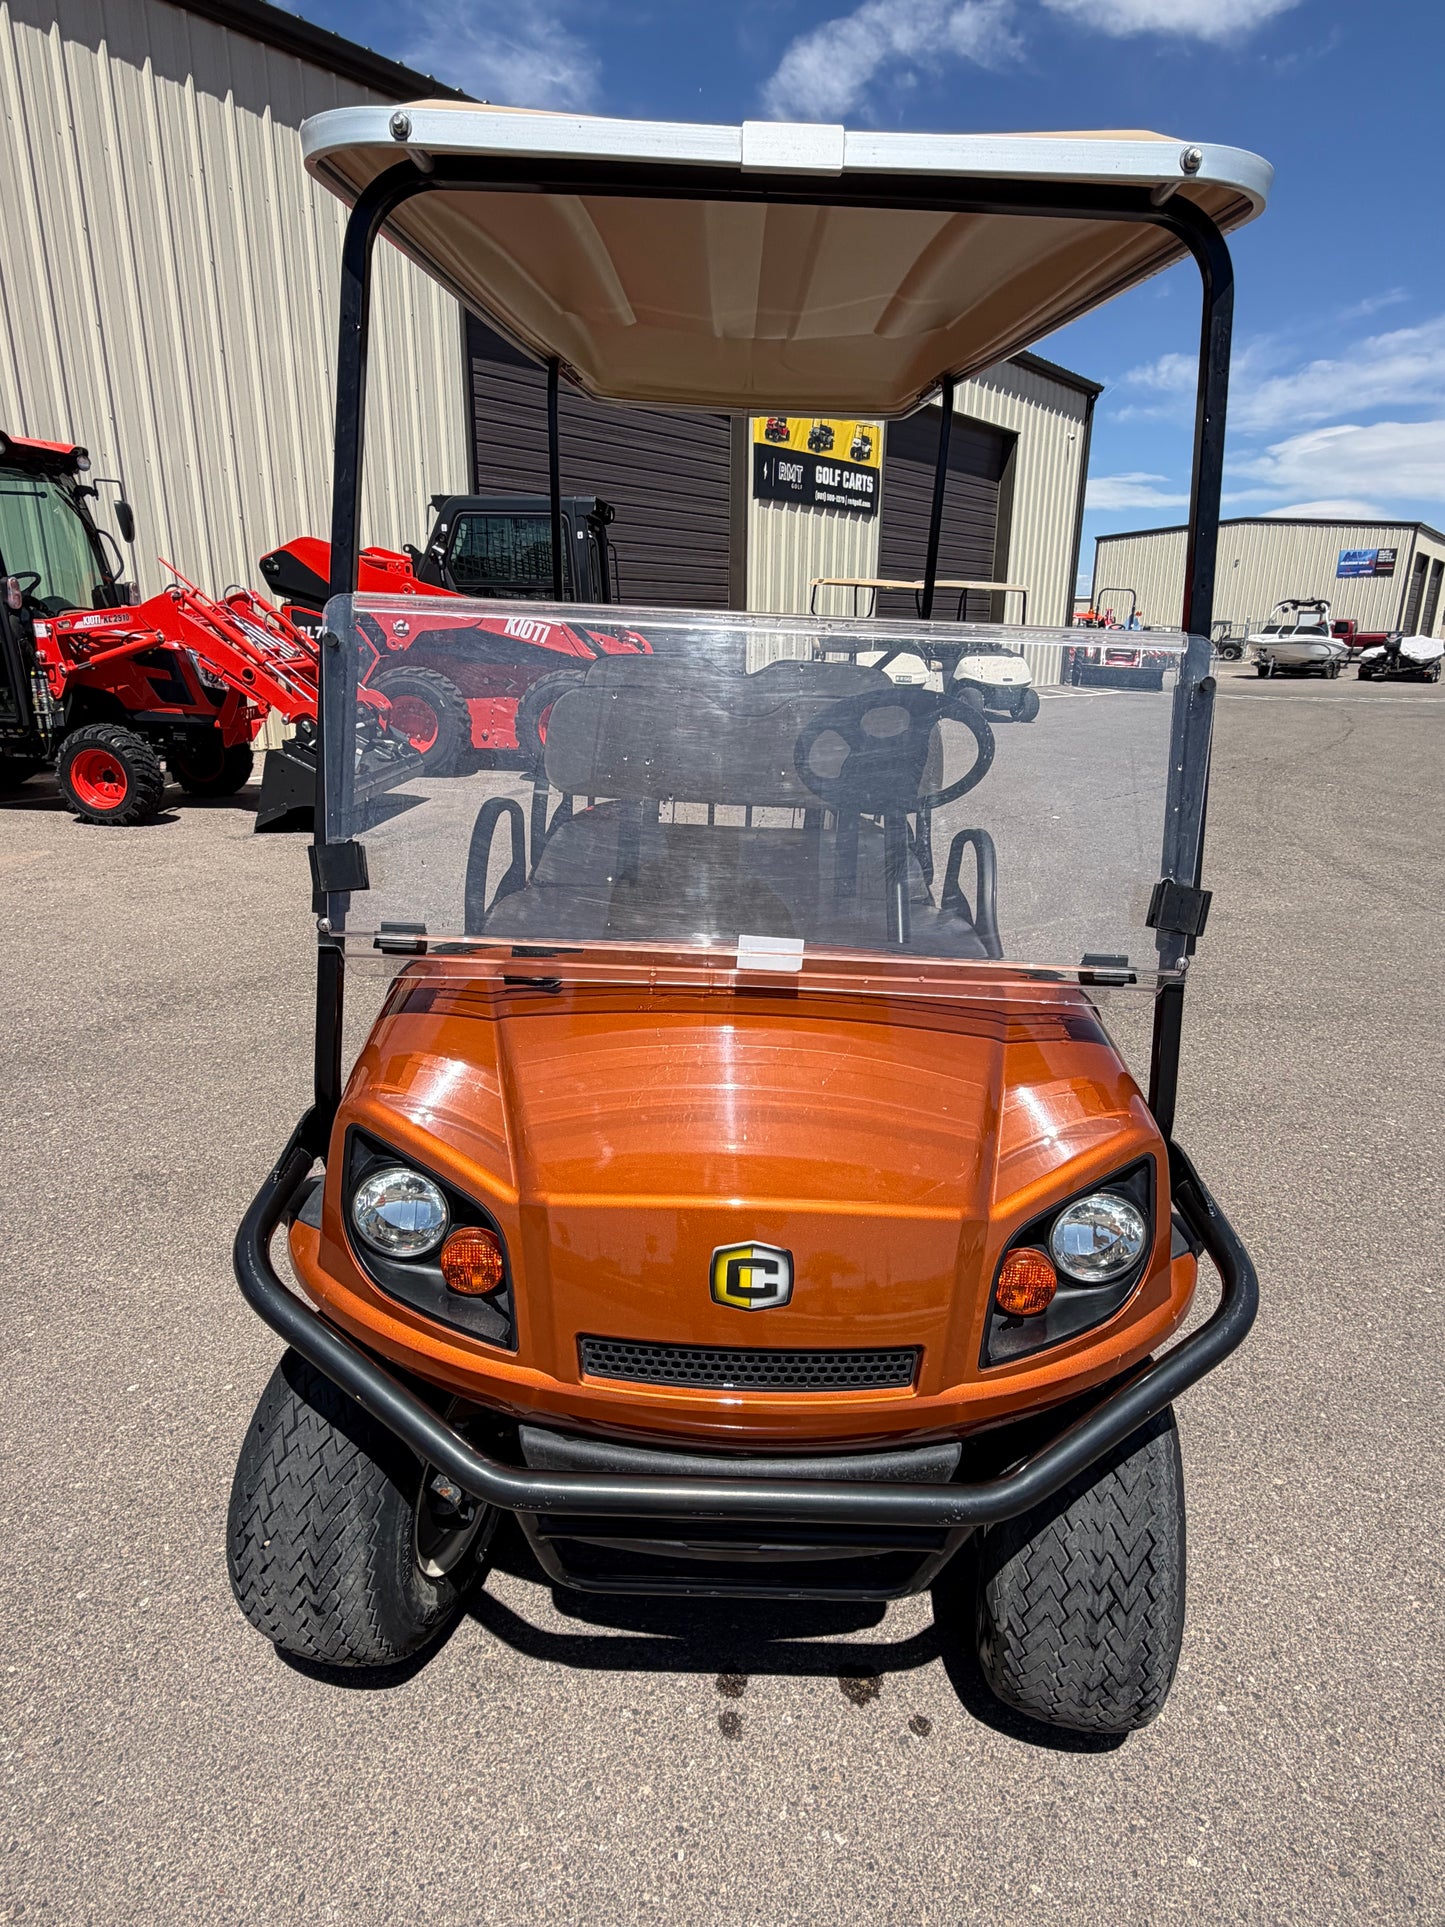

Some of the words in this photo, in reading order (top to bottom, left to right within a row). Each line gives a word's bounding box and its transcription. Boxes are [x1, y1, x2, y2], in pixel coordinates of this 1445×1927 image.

[778, 461, 804, 483] RMT
[815, 465, 841, 487] GOLF
[842, 470, 874, 493] CARTS
[503, 618, 551, 644] KIOTI
